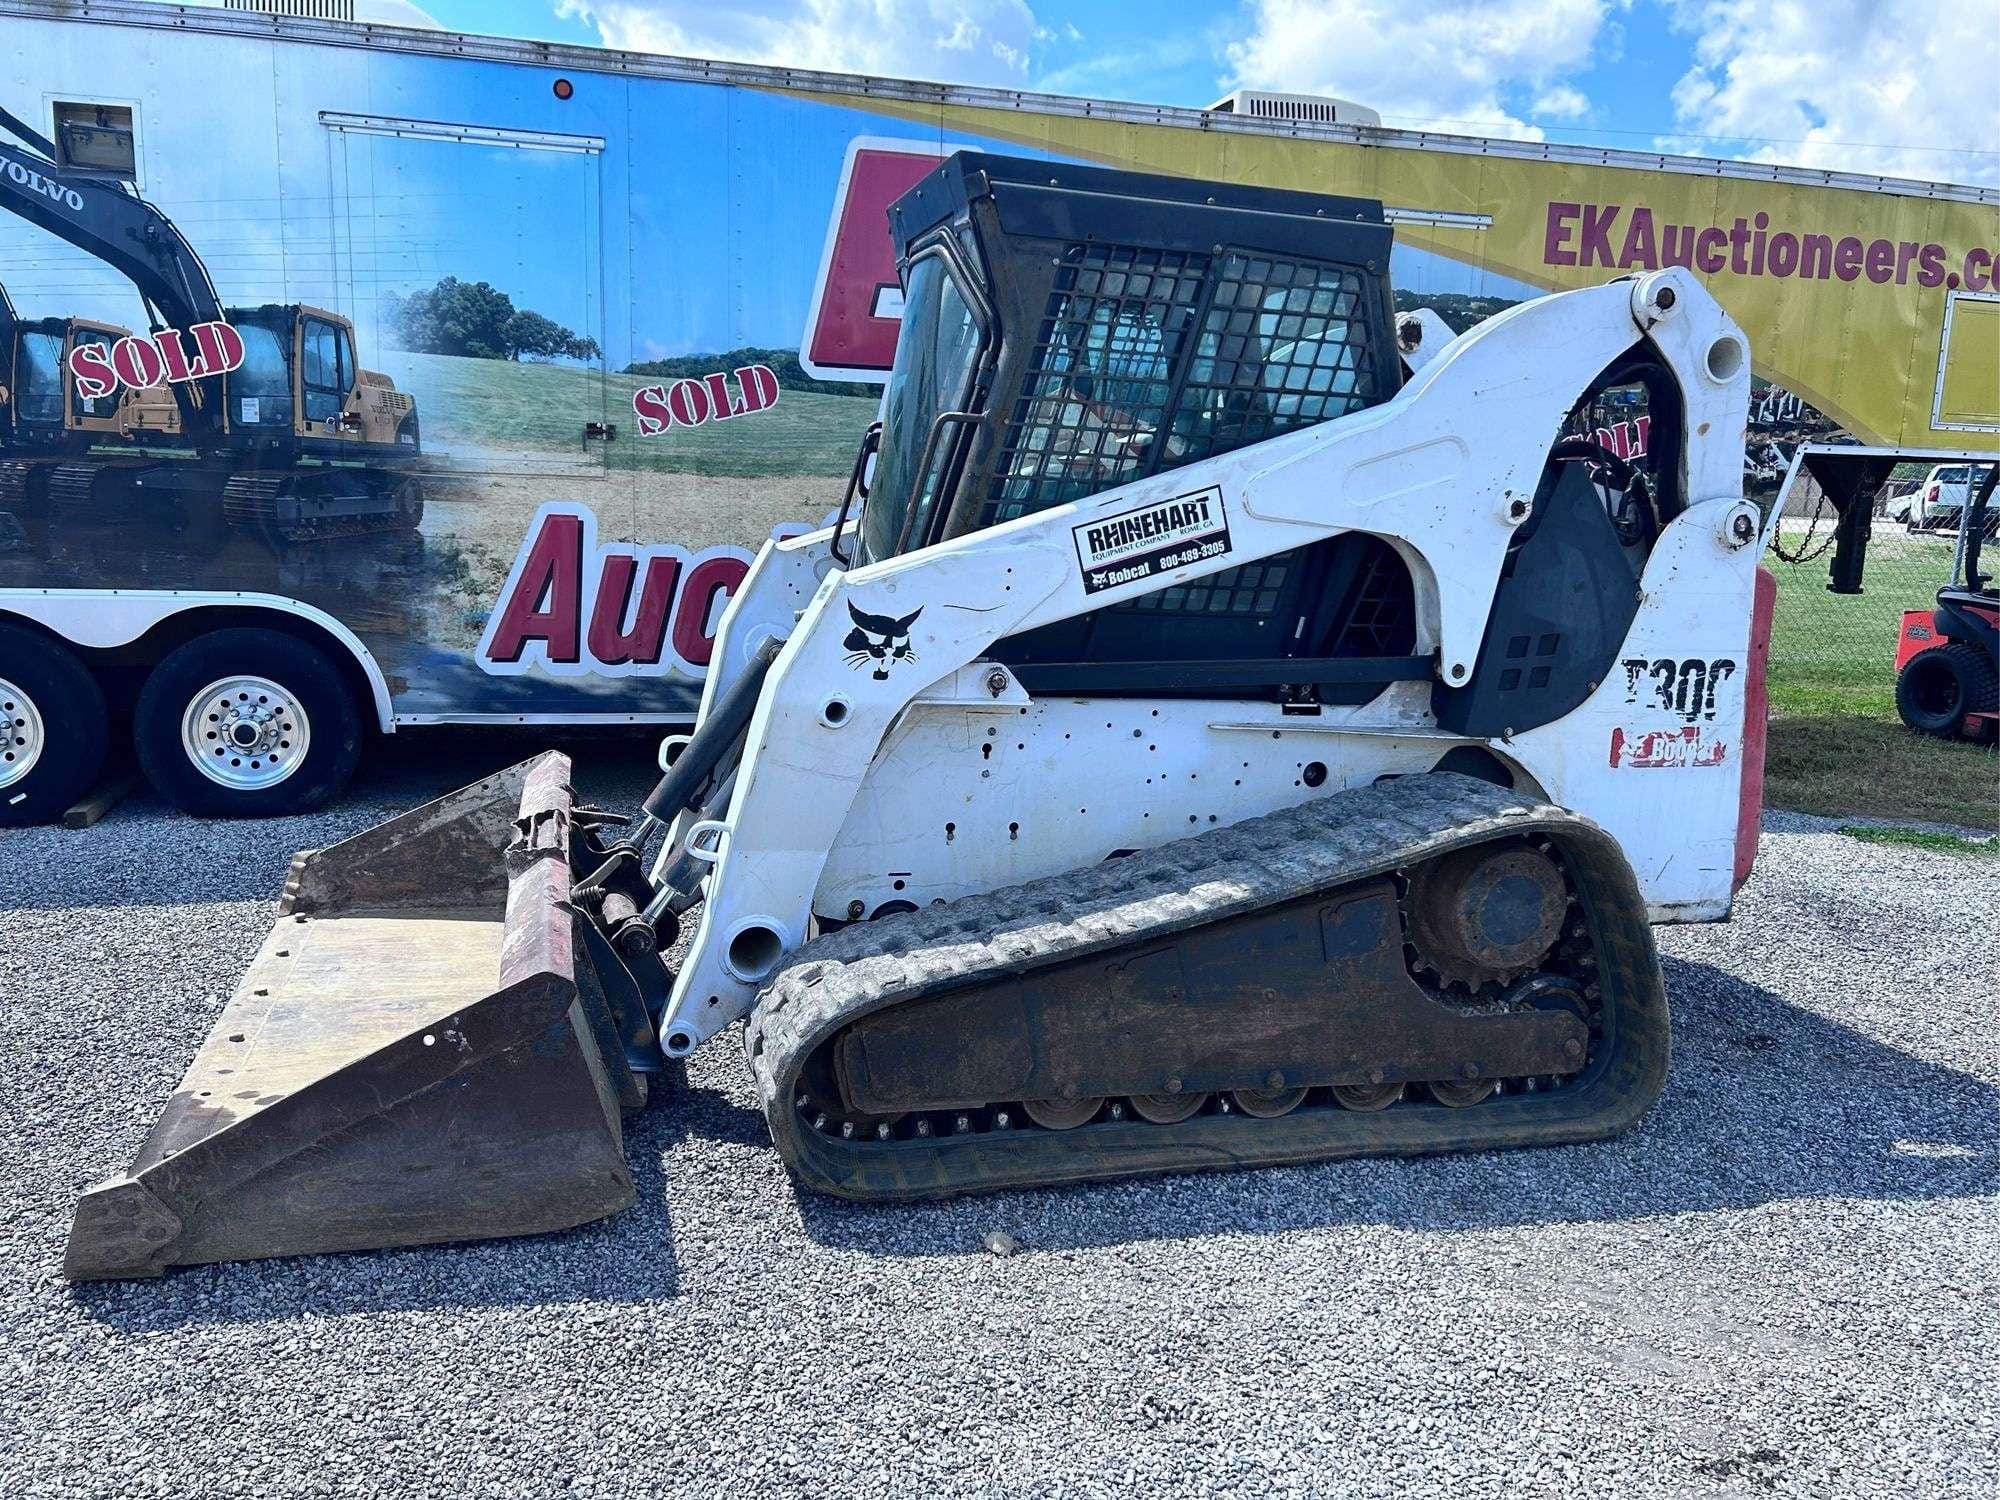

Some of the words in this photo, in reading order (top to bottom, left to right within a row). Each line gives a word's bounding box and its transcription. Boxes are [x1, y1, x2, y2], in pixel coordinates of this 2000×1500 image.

[70, 321, 245, 399] SOLD
[633, 365, 779, 436] SOLD
[1087, 496, 1209, 554] RHINEHART
[1092, 544, 1134, 561] EQUIPMENT
[1135, 533, 1170, 549] COMPANY
[1204, 520, 1214, 529] GA
[486, 514, 758, 667] Auc
[1108, 562, 1150, 584] Bobcat
[1160, 540, 1225, 569] 800-489-3305
